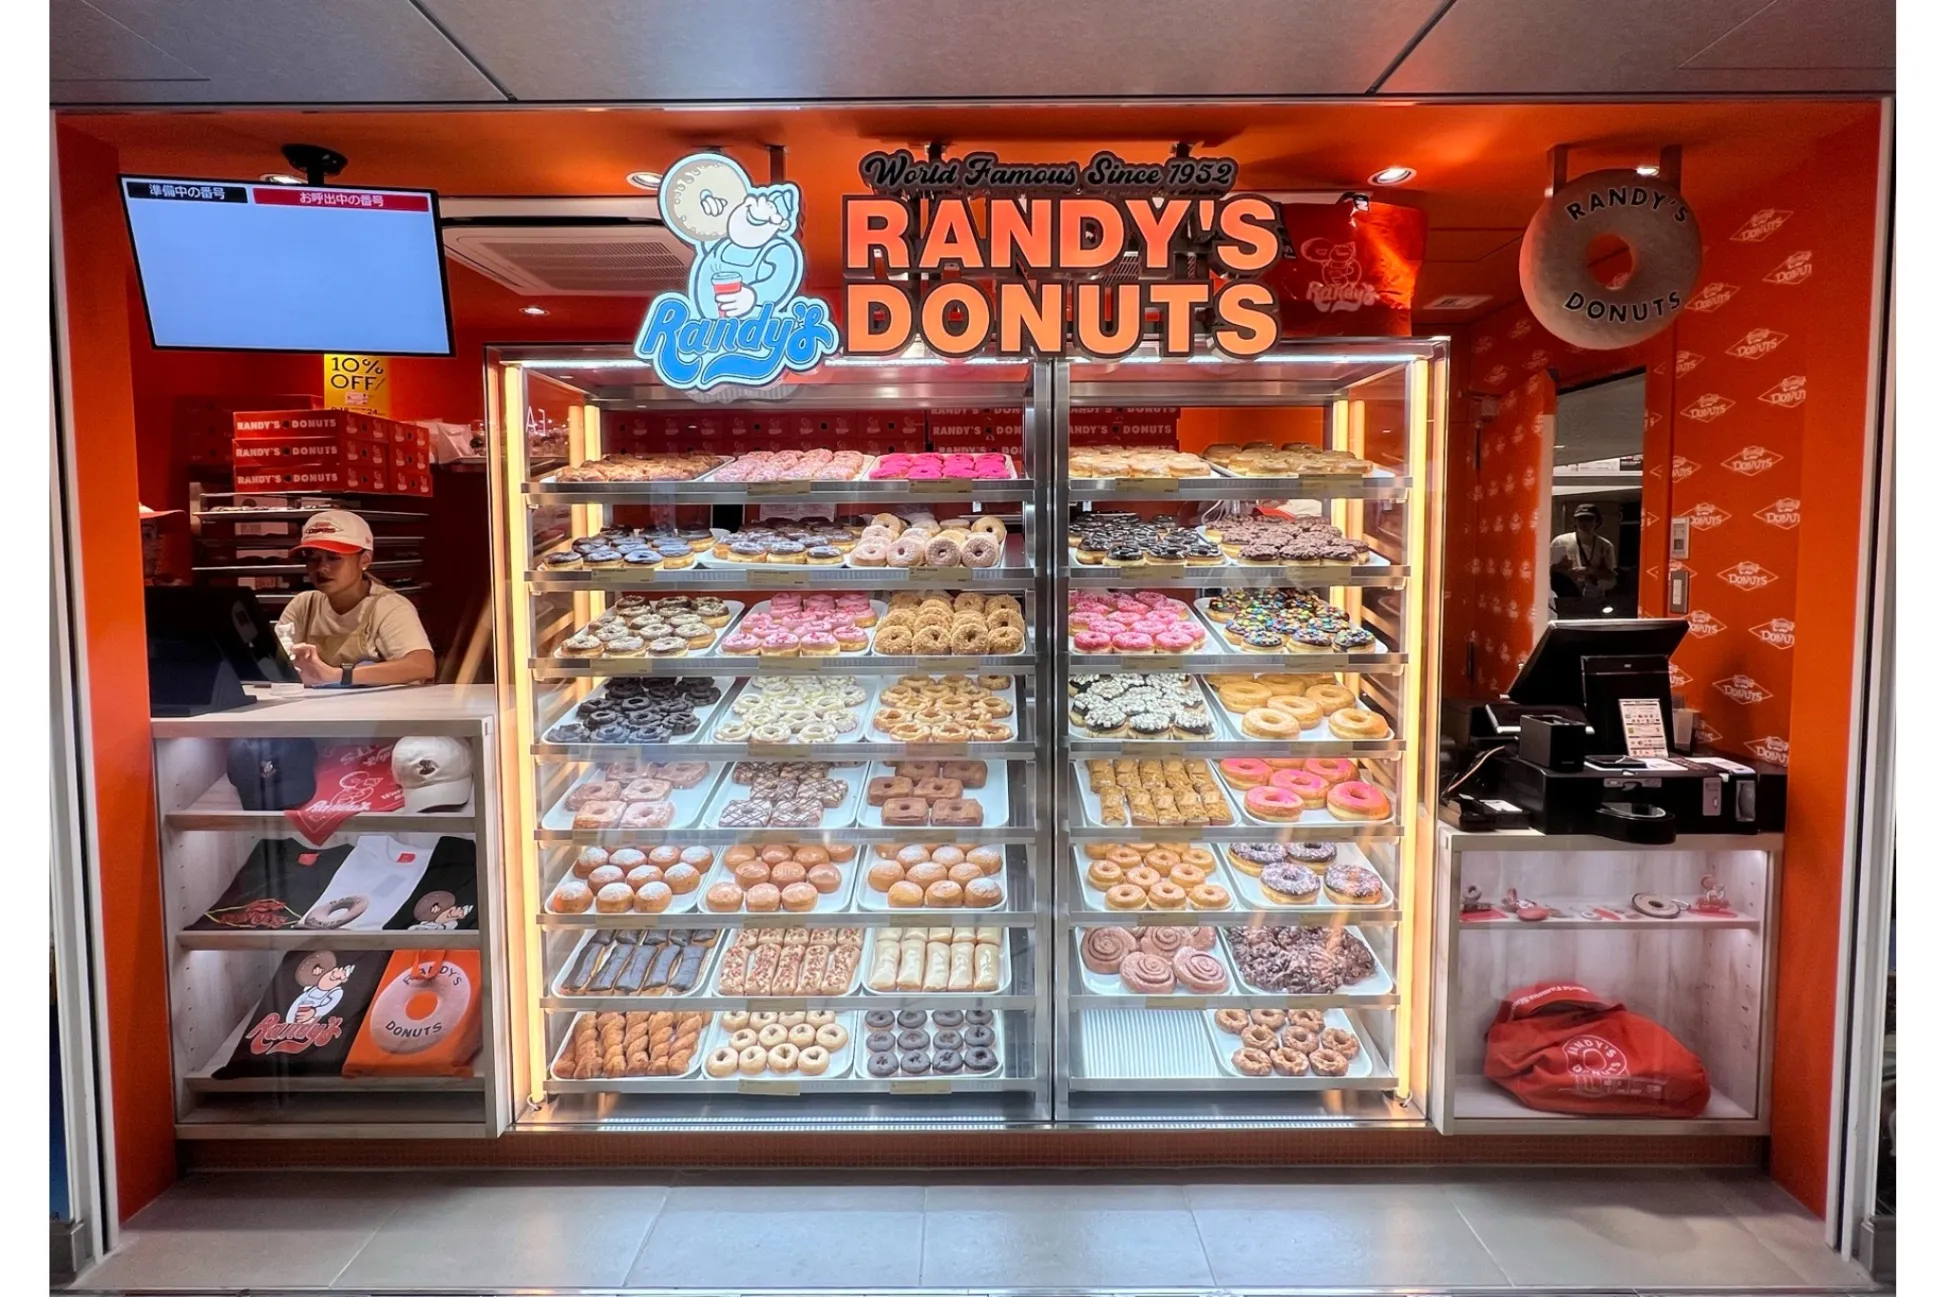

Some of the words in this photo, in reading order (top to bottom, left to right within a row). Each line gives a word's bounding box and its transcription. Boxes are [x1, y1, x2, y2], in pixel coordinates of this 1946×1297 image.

[864, 155, 957, 186] World
[962, 156, 1077, 186] Famous
[1087, 154, 1162, 185] Since
[1168, 161, 1233, 185] 1952
[149, 183, 225, 200] 準備中の番号
[300, 191, 384, 208] お呼出中の番号
[1566, 187, 1688, 222] RANDY'S
[847, 198, 1278, 271] RANDY'S
[1306, 281, 1380, 313] Randy's
[1564, 291, 1681, 323] DONUTS
[847, 283, 1278, 354] DONUTS
[642, 299, 833, 384] Randy's
[332, 357, 384, 374] 10%
[237, 420, 281, 430] RANDY'S
[291, 419, 337, 428] DONUTS
[933, 426, 981, 435] RANDY'S
[996, 426, 1022, 435] DON
[1069, 425, 1109, 434] ANDY'S
[1123, 425, 1172, 434] DONUTS
[235, 446, 281, 457] RANDY'S
[292, 446, 338, 456] DONUTS
[237, 475, 282, 485] RANDY'S
[293, 473, 338, 483] DONUTS
[246, 1012, 343, 1055] Randy's
[385, 1021, 443, 1038] DONUTS
